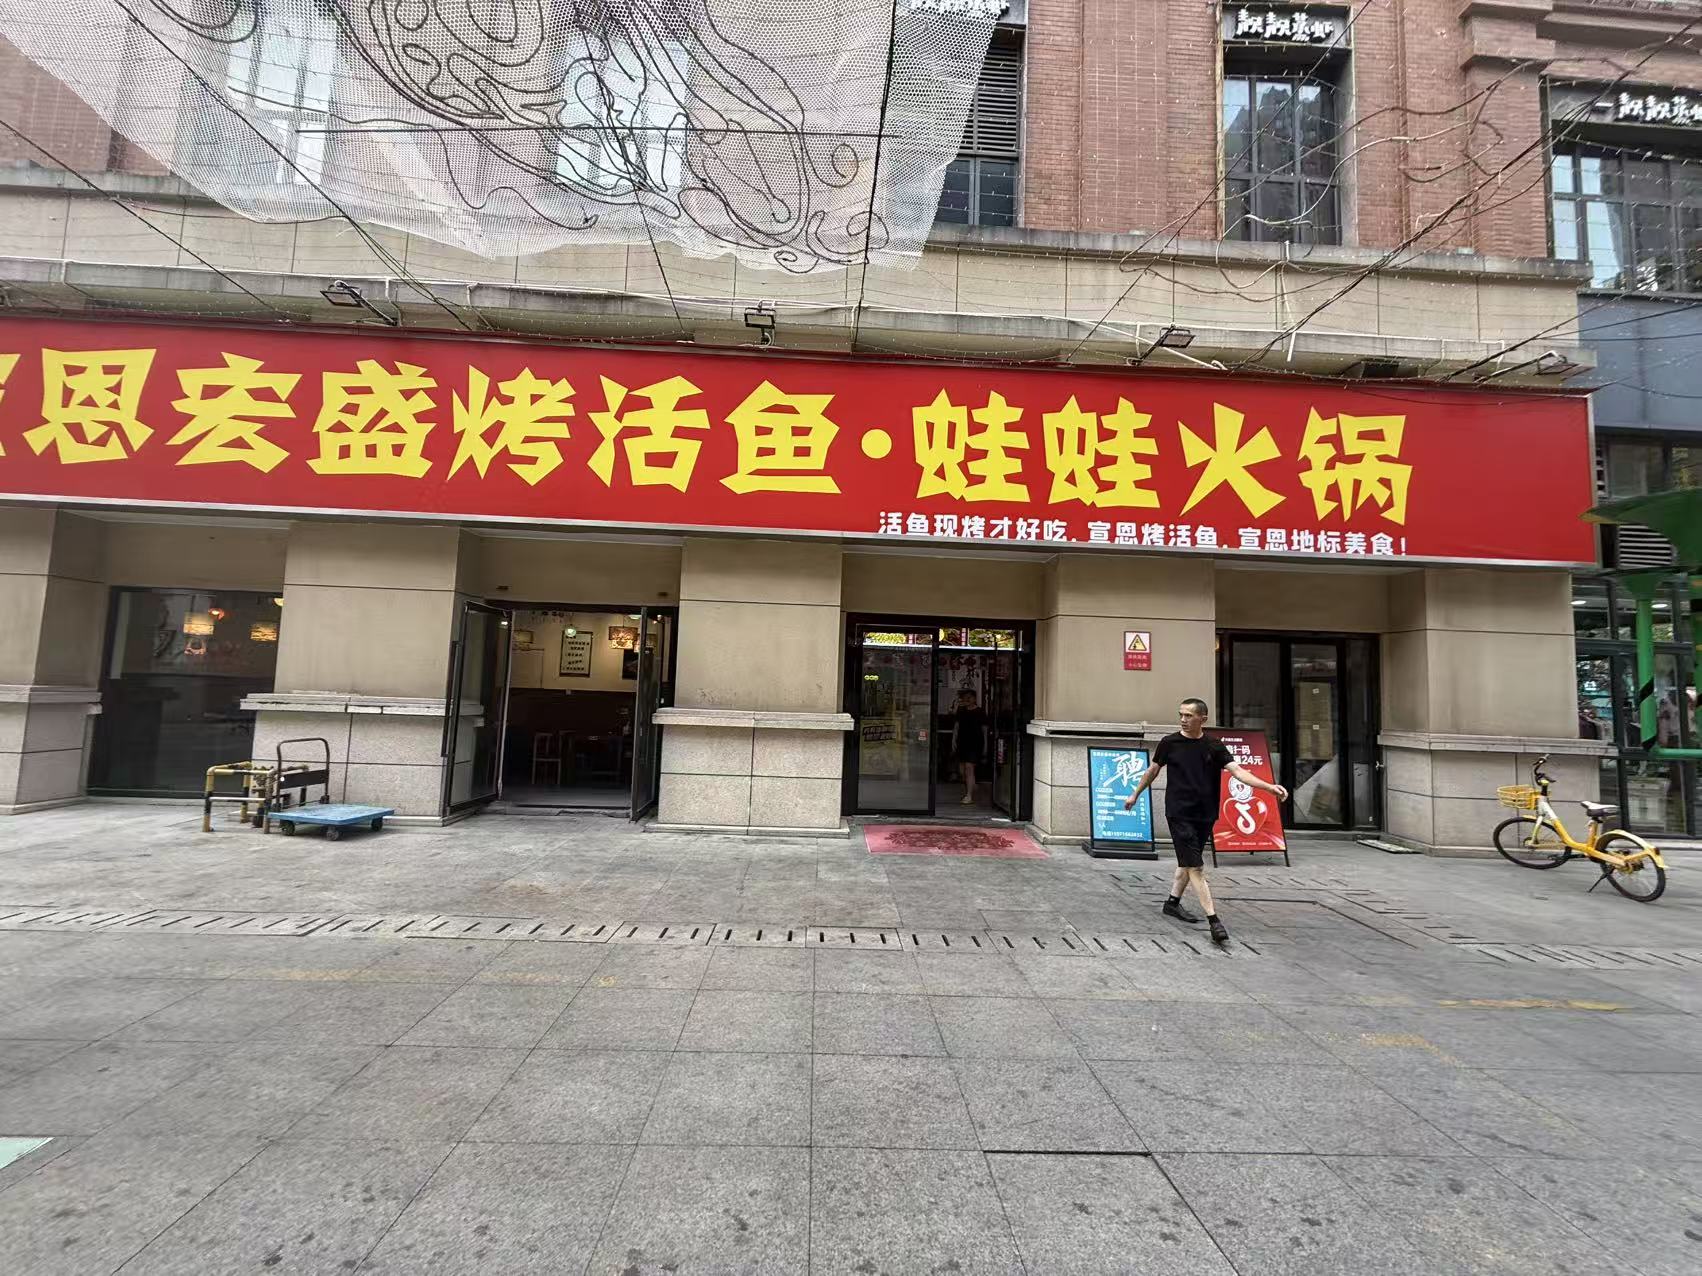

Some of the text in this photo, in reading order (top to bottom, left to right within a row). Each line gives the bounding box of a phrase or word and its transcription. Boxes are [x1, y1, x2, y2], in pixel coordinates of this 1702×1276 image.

[0, 347, 1413, 526] 恩宏盛烤活鱼·蛙蛙火锅
